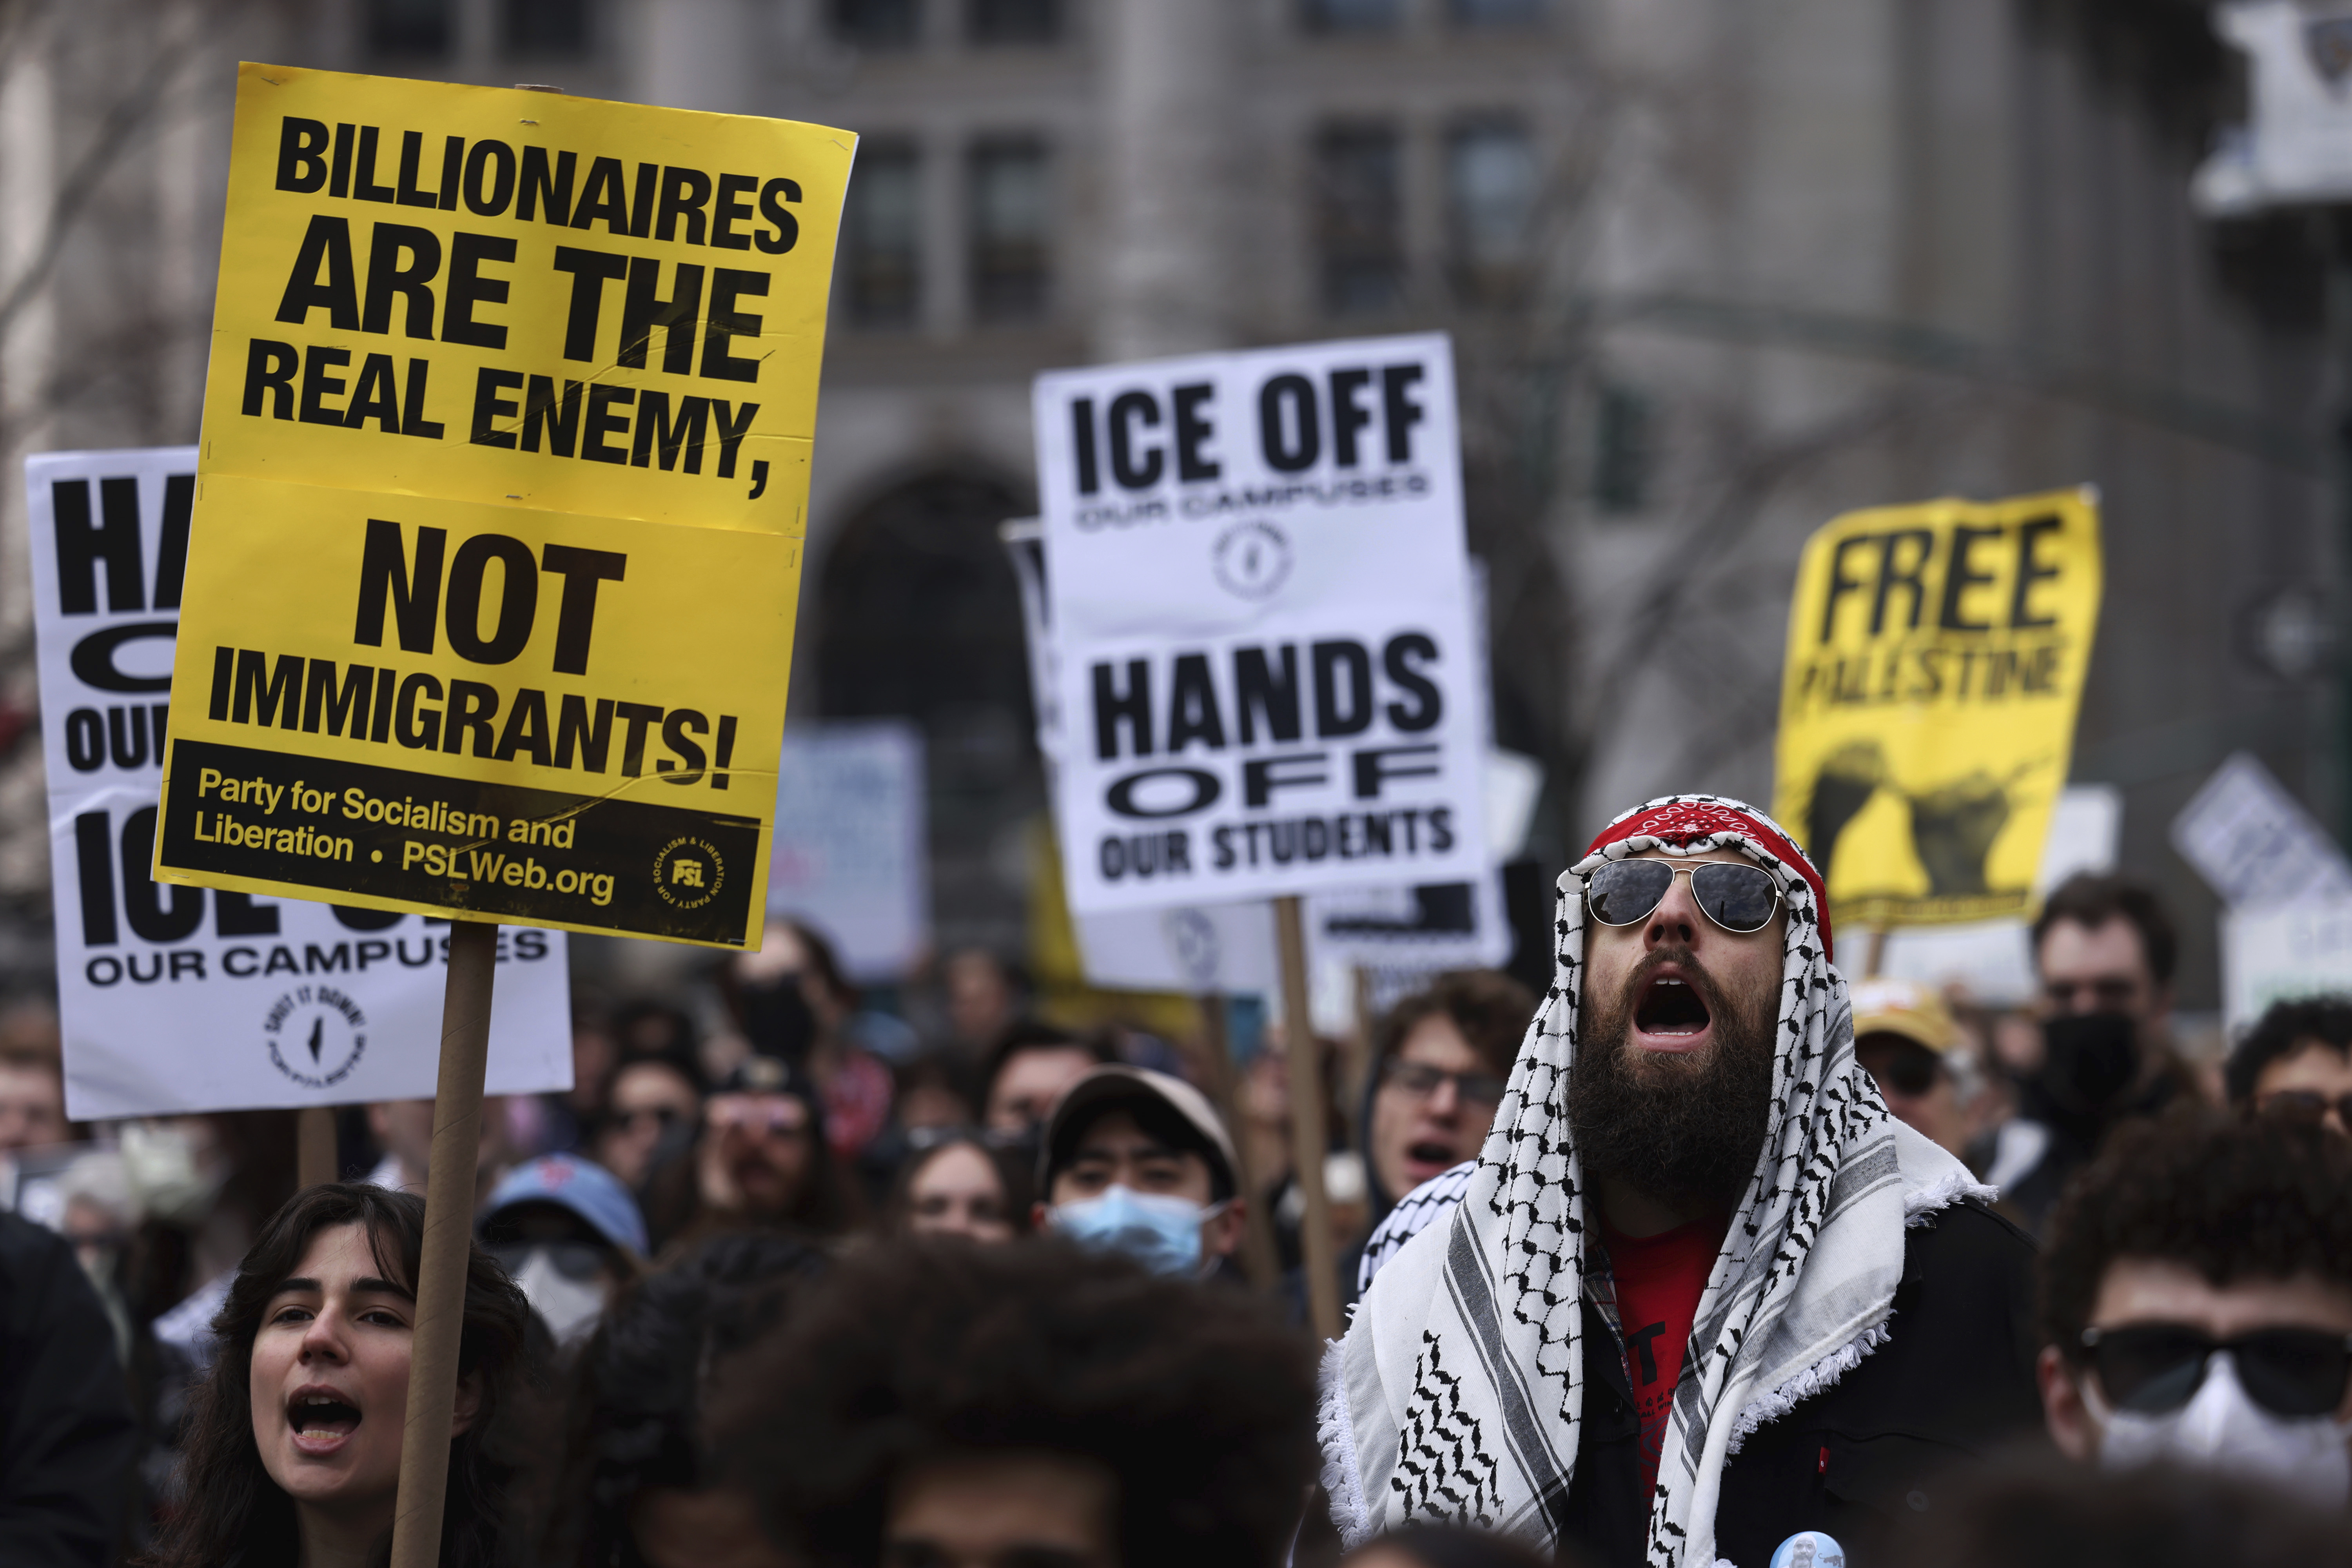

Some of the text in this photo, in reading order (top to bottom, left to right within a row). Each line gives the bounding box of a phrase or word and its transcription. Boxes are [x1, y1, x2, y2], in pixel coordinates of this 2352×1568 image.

[275, 116, 802, 255] BILLIONAIRES
[274, 214, 771, 383] ARE THE
[241, 338, 770, 500] REAL ENEMY,
[1070, 361, 1425, 497] ICE OFF
[1075, 473, 1431, 532] OUR CAMPUSES
[354, 518, 627, 676] NOT
[1820, 514, 2064, 644] FREE
[208, 646, 738, 791] IMMIGRANTS!
[1091, 631, 1444, 762] HANDS
[199, 768, 576, 849] Party for Socialism and
[1104, 743, 1440, 821] OFF
[195, 811, 615, 906] Liberation PSLWeb.org
[653, 836, 725, 909] PARTY FOR SOCIALISM & LIBERATION
[671, 866, 705, 888] PSL
[1099, 806, 1455, 882] OUR STUDENTS
[85, 930, 549, 986] OUR CAMPUS
[264, 993, 296, 1034] SHUT
[297, 985, 311, 1004] IT
